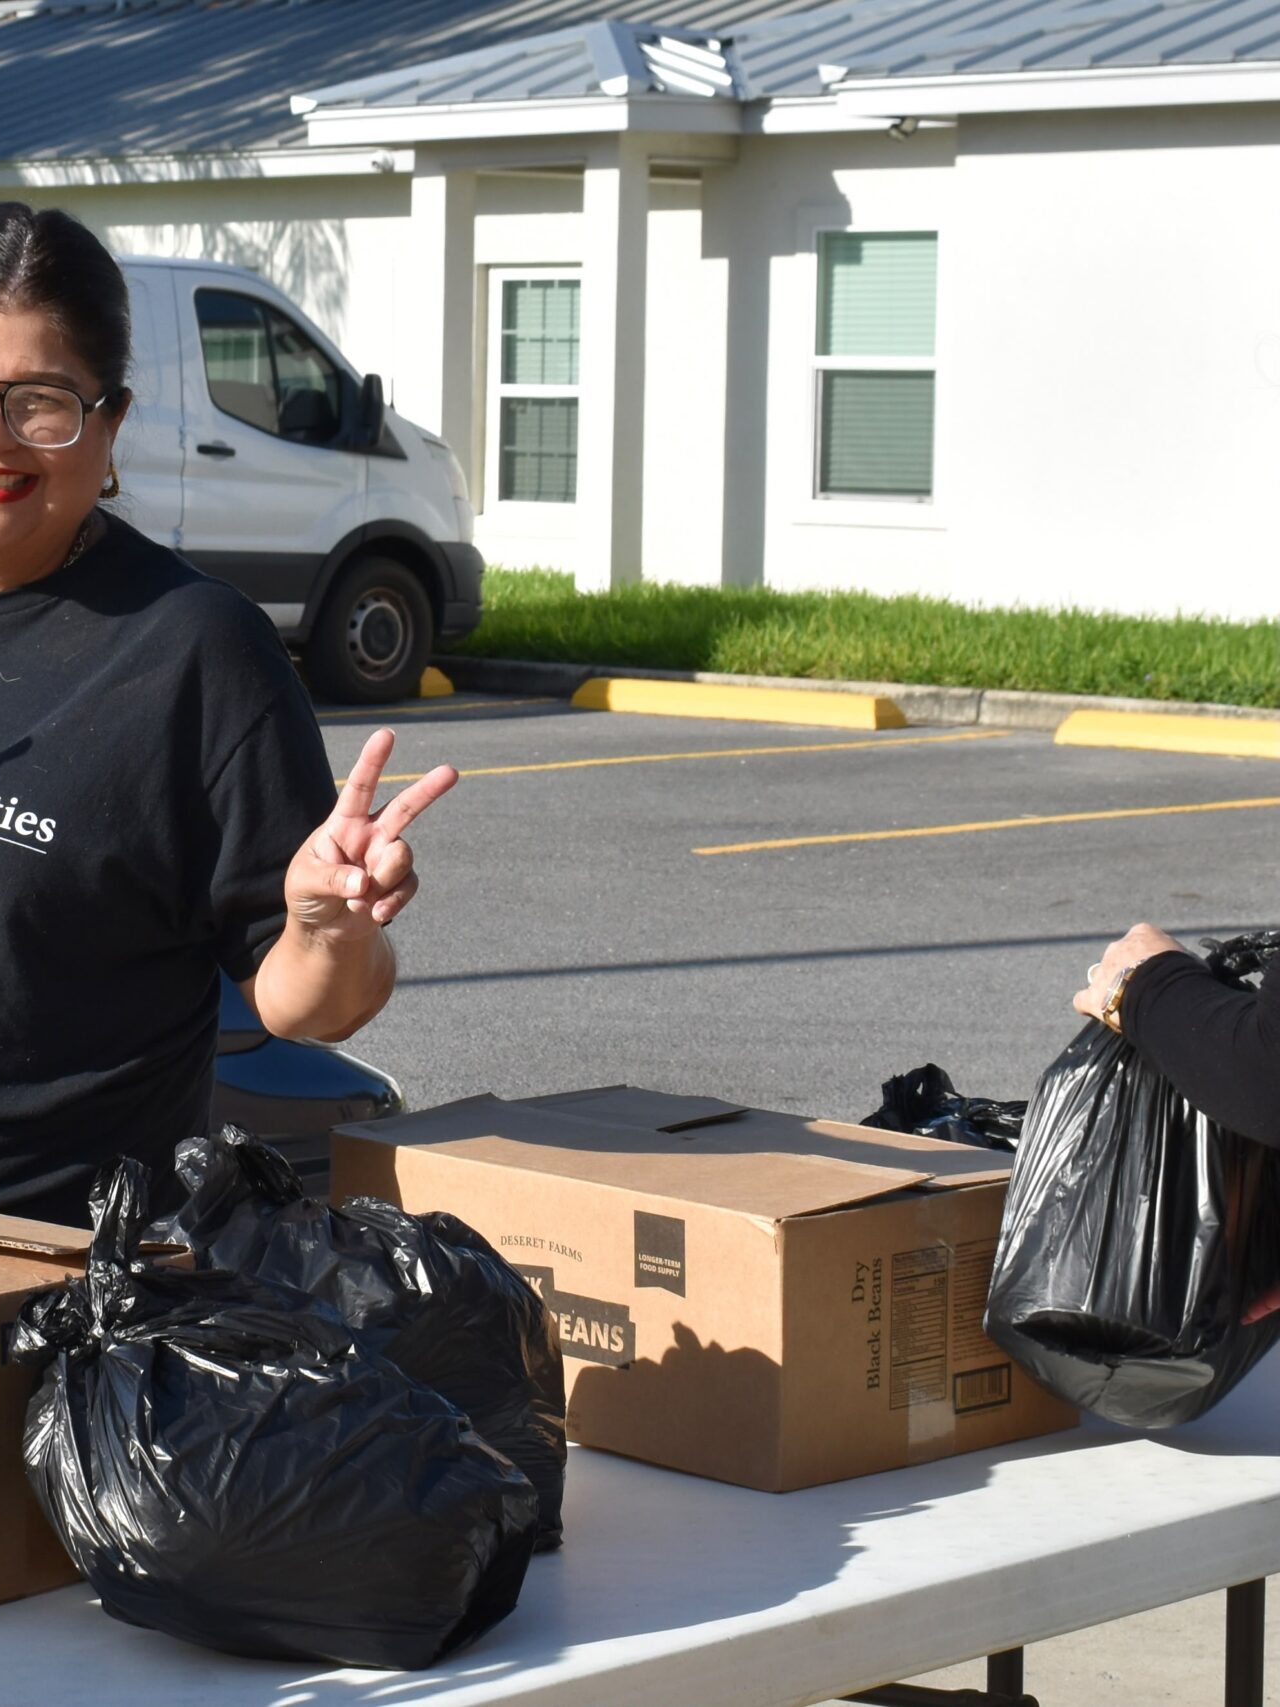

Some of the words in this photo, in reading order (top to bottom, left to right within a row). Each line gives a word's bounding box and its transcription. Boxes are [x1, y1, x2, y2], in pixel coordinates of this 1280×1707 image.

[500, 1235, 546, 1249] DESERET
[548, 1240, 583, 1263] FARMS
[638, 1253, 681, 1269] LONGER-TERM
[640, 1262, 657, 1273] FOOD
[657, 1265, 680, 1278] SUPPLY
[851, 1260, 870, 1304] Dry
[867, 1256, 883, 1323] Beans
[551, 1311, 624, 1353] EANS
[866, 1329, 881, 1391] Black
